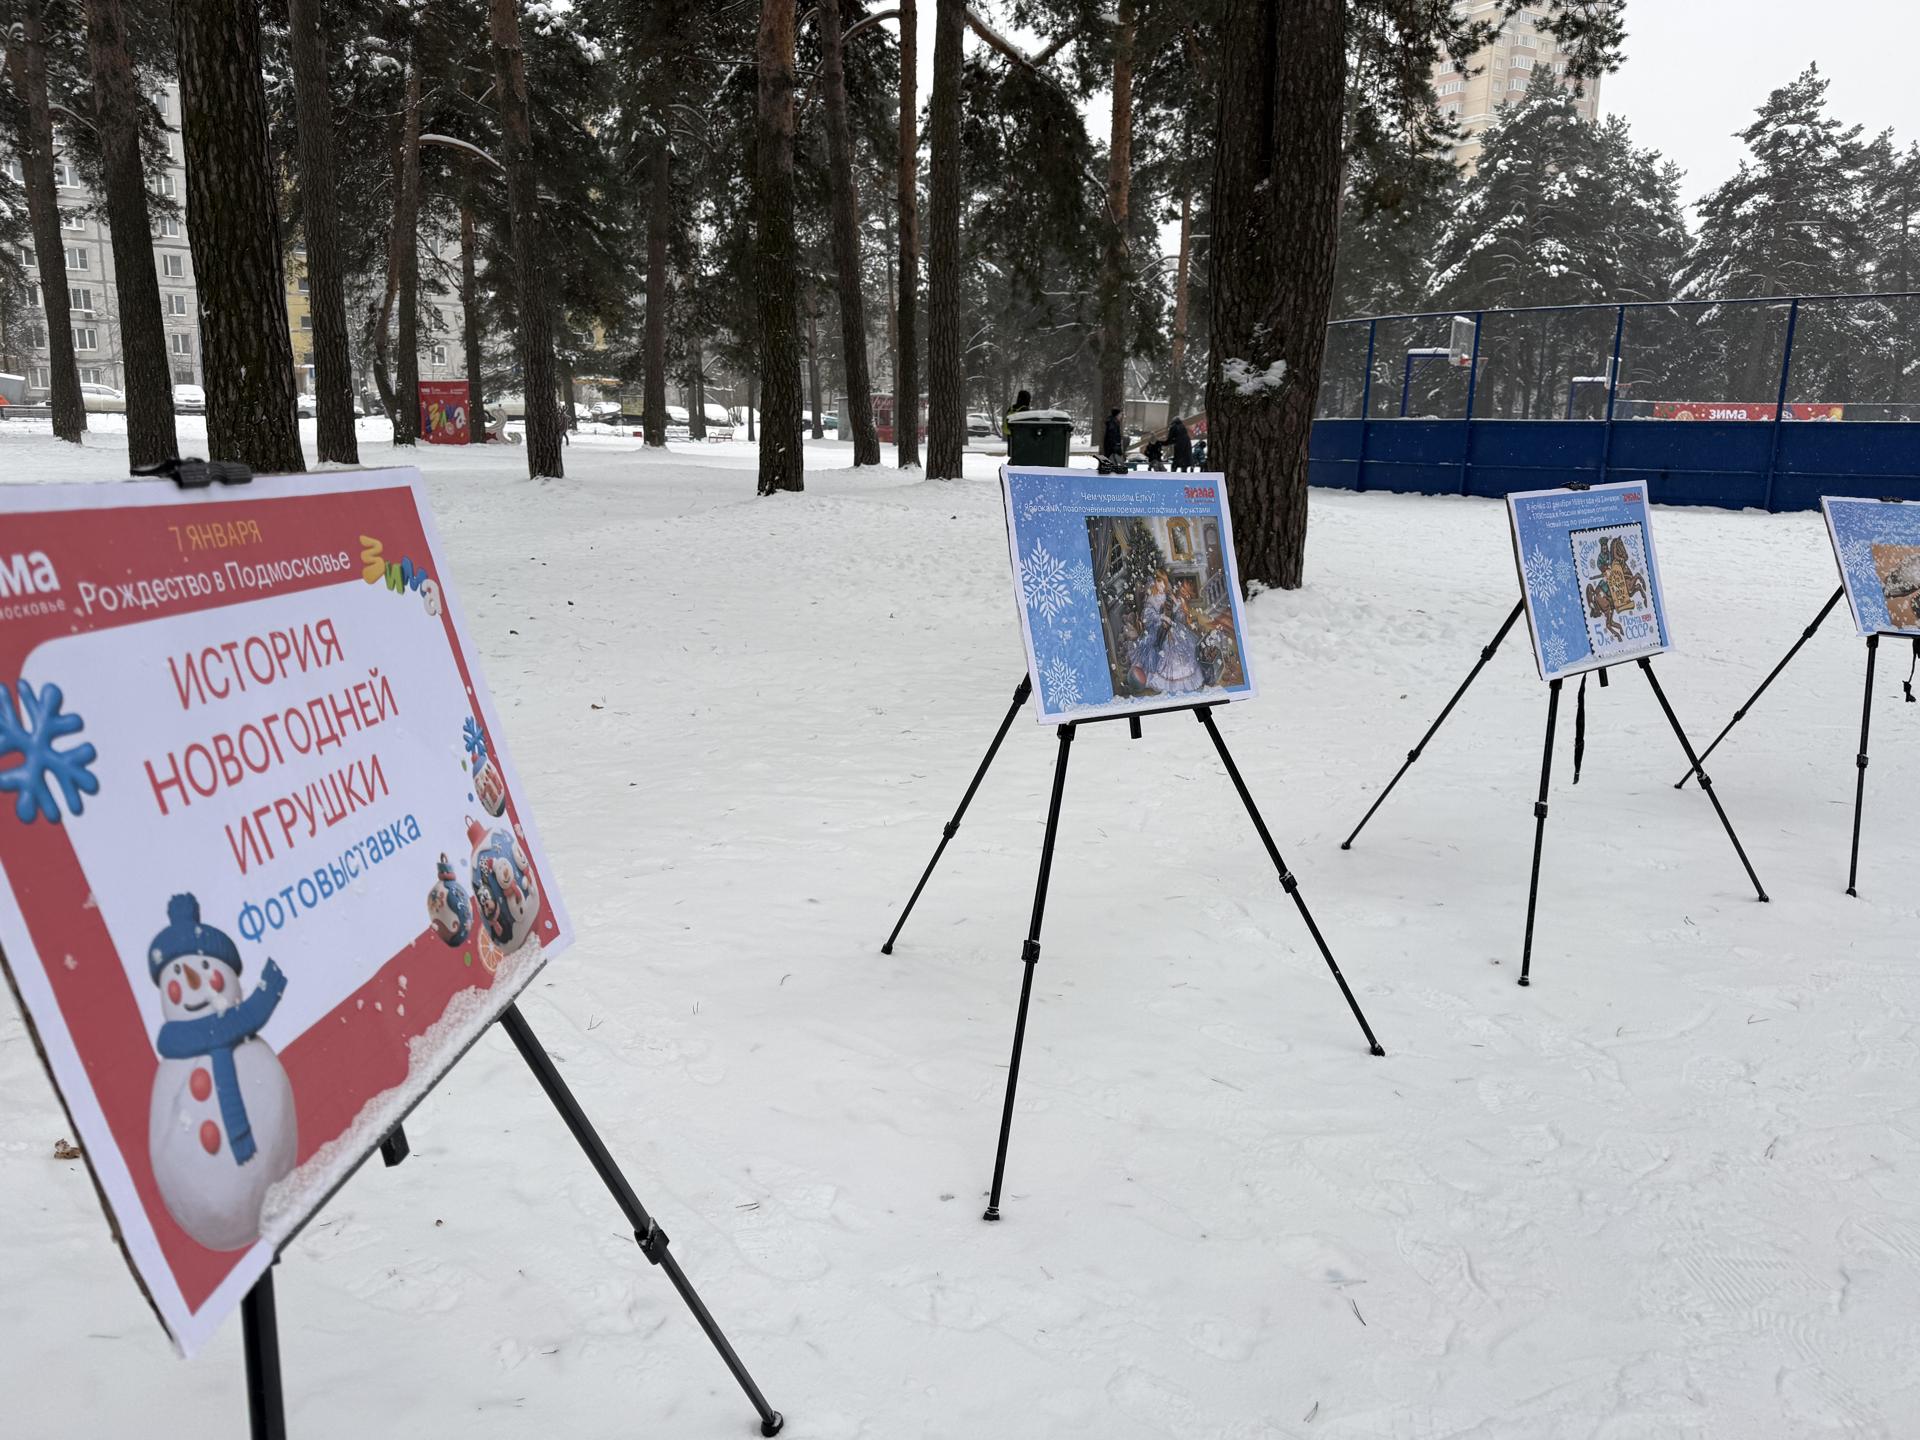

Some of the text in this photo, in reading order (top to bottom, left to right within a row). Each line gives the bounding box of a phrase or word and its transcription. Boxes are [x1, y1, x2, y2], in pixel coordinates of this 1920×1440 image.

[1708, 409, 1747, 420] зима
[169, 520, 263, 552] 7 ЯНВАРЯ
[77, 551, 351, 615] Рождество в Подмосковье
[1625, 622, 1649, 640] СССР
[167, 618, 344, 710] ИСТОРИЯ
[143, 666, 399, 817] НОВОГОДНЕЙ
[224, 753, 389, 876] ИГРУШКИ
